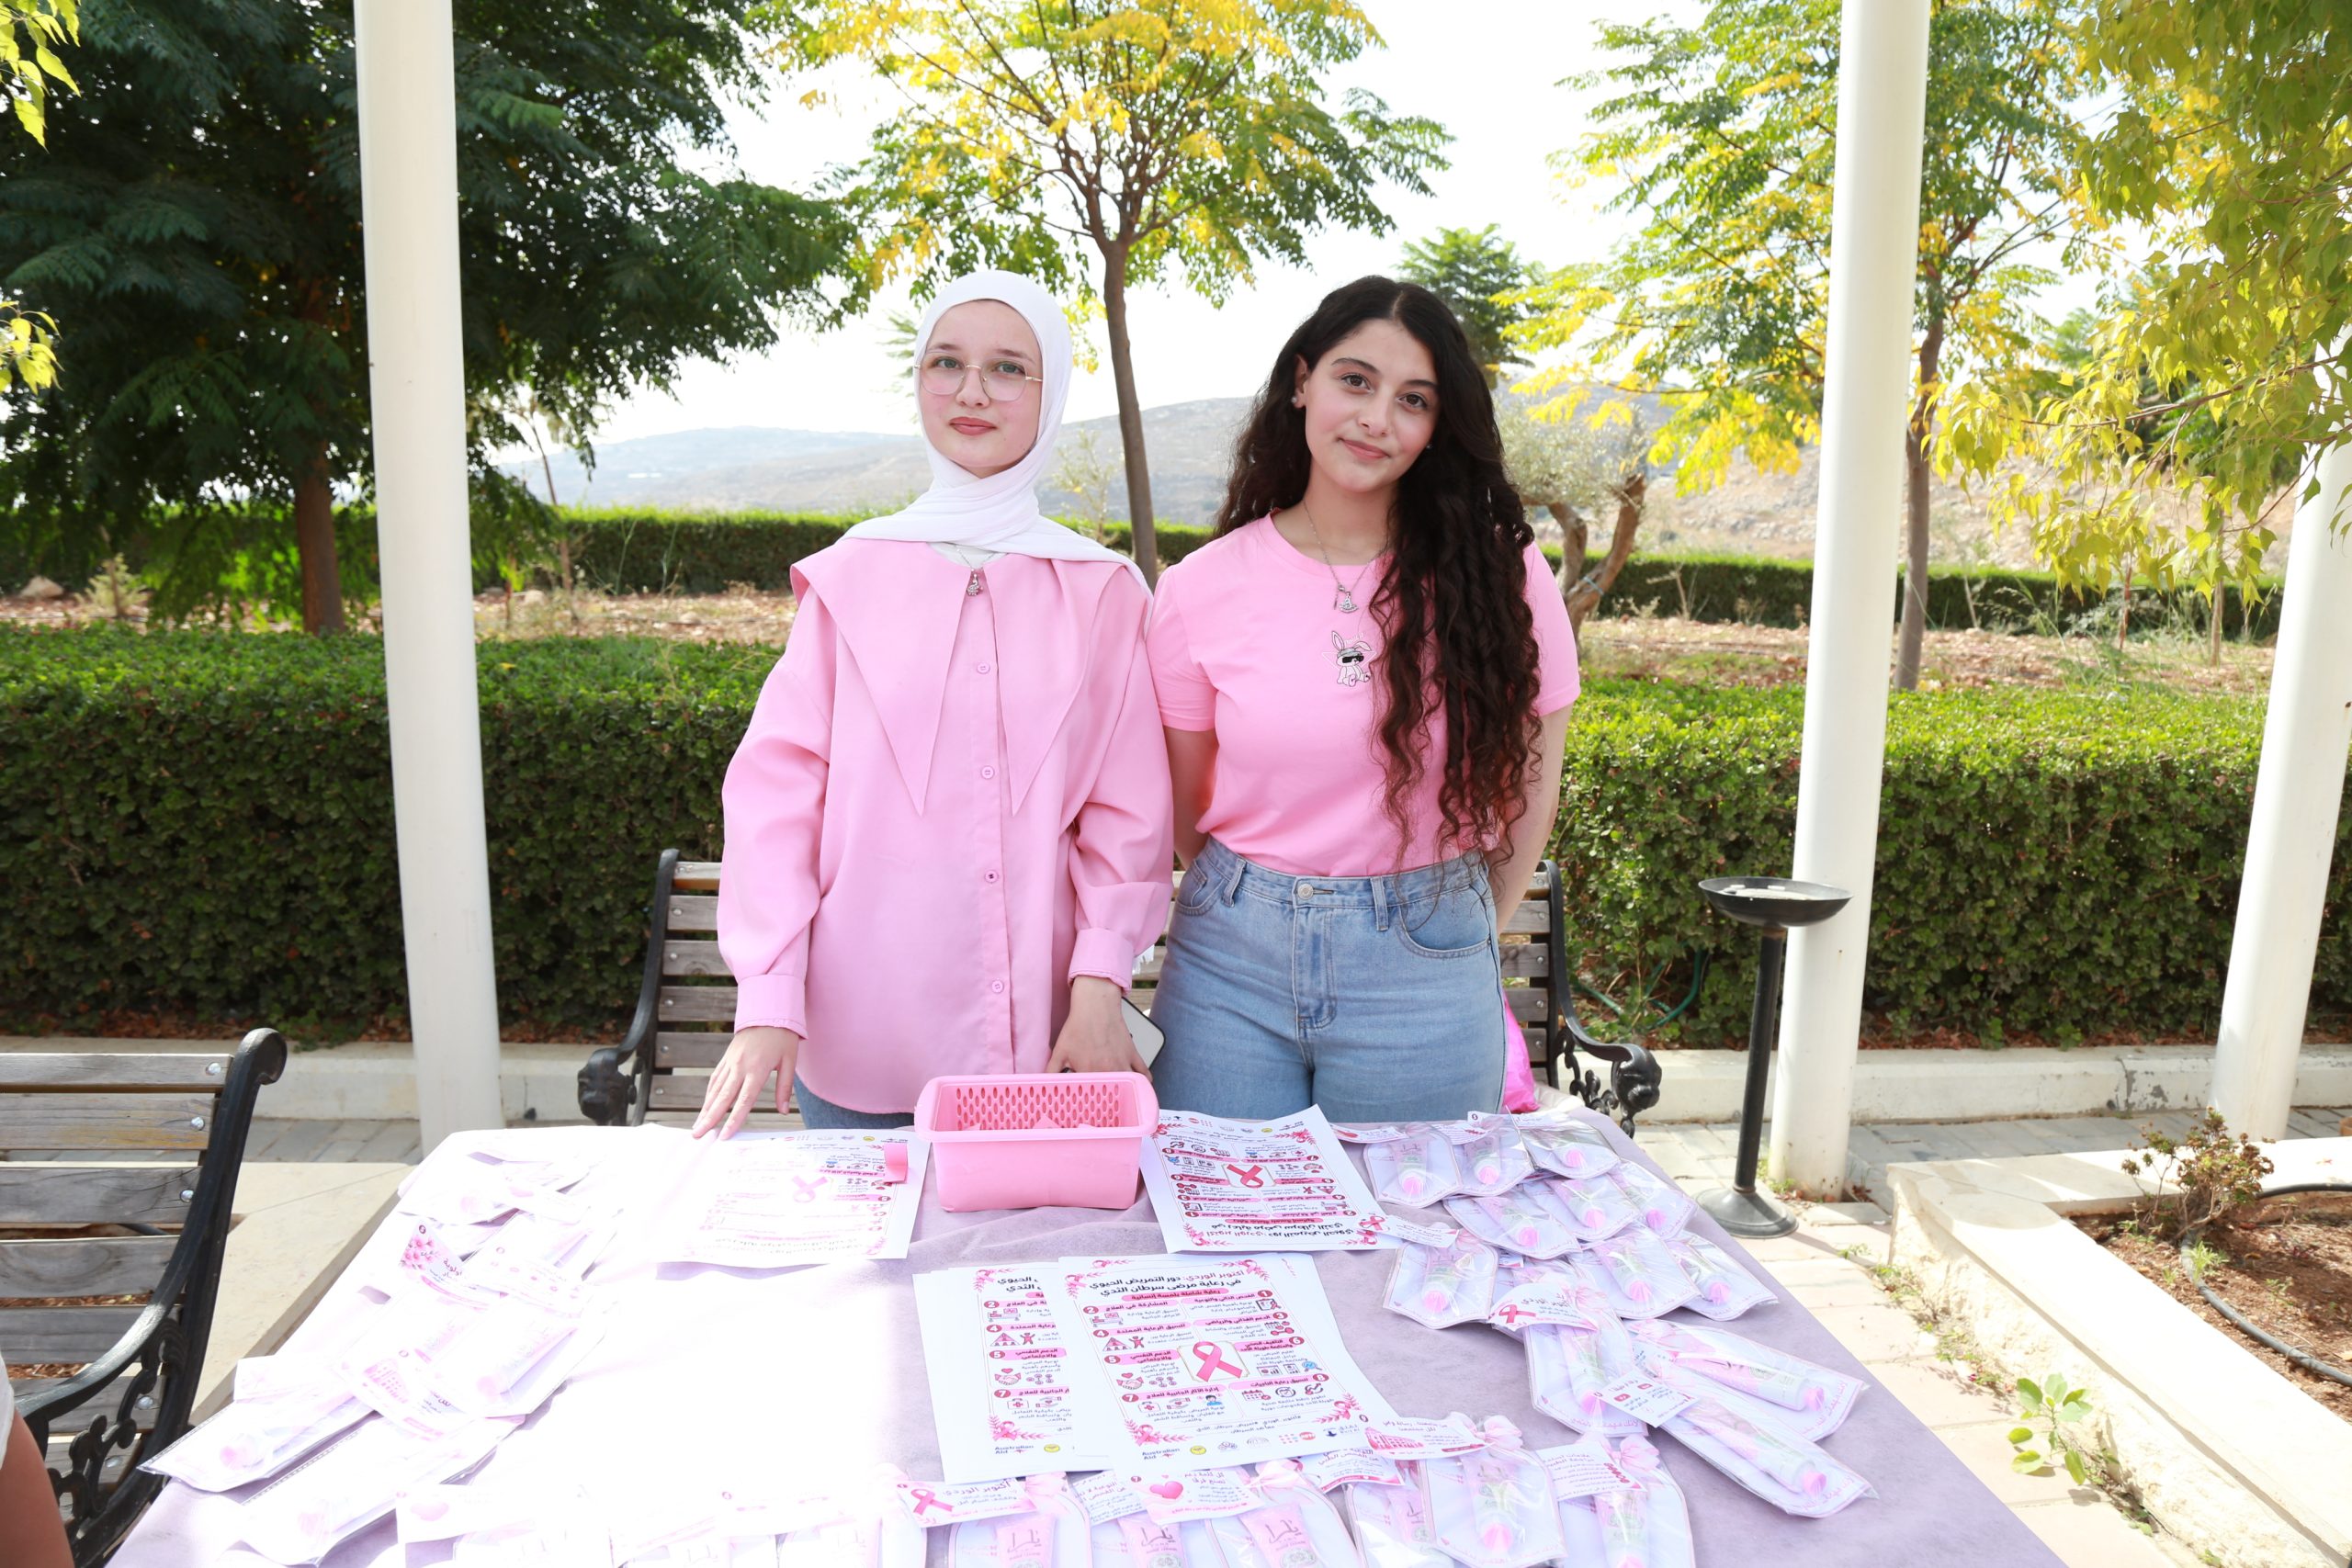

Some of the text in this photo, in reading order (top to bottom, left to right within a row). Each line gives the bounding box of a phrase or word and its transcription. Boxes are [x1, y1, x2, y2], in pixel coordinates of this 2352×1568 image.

[997, 1276, 1032, 1285] الحيوي
[1090, 1279, 1124, 1289] الحيوي
[1125, 1275, 1164, 1285] التمريض
[1227, 1279, 1241, 1287] في
[1167, 1282, 1197, 1291] مرضى
[1100, 1286, 1128, 1297] الثدي
